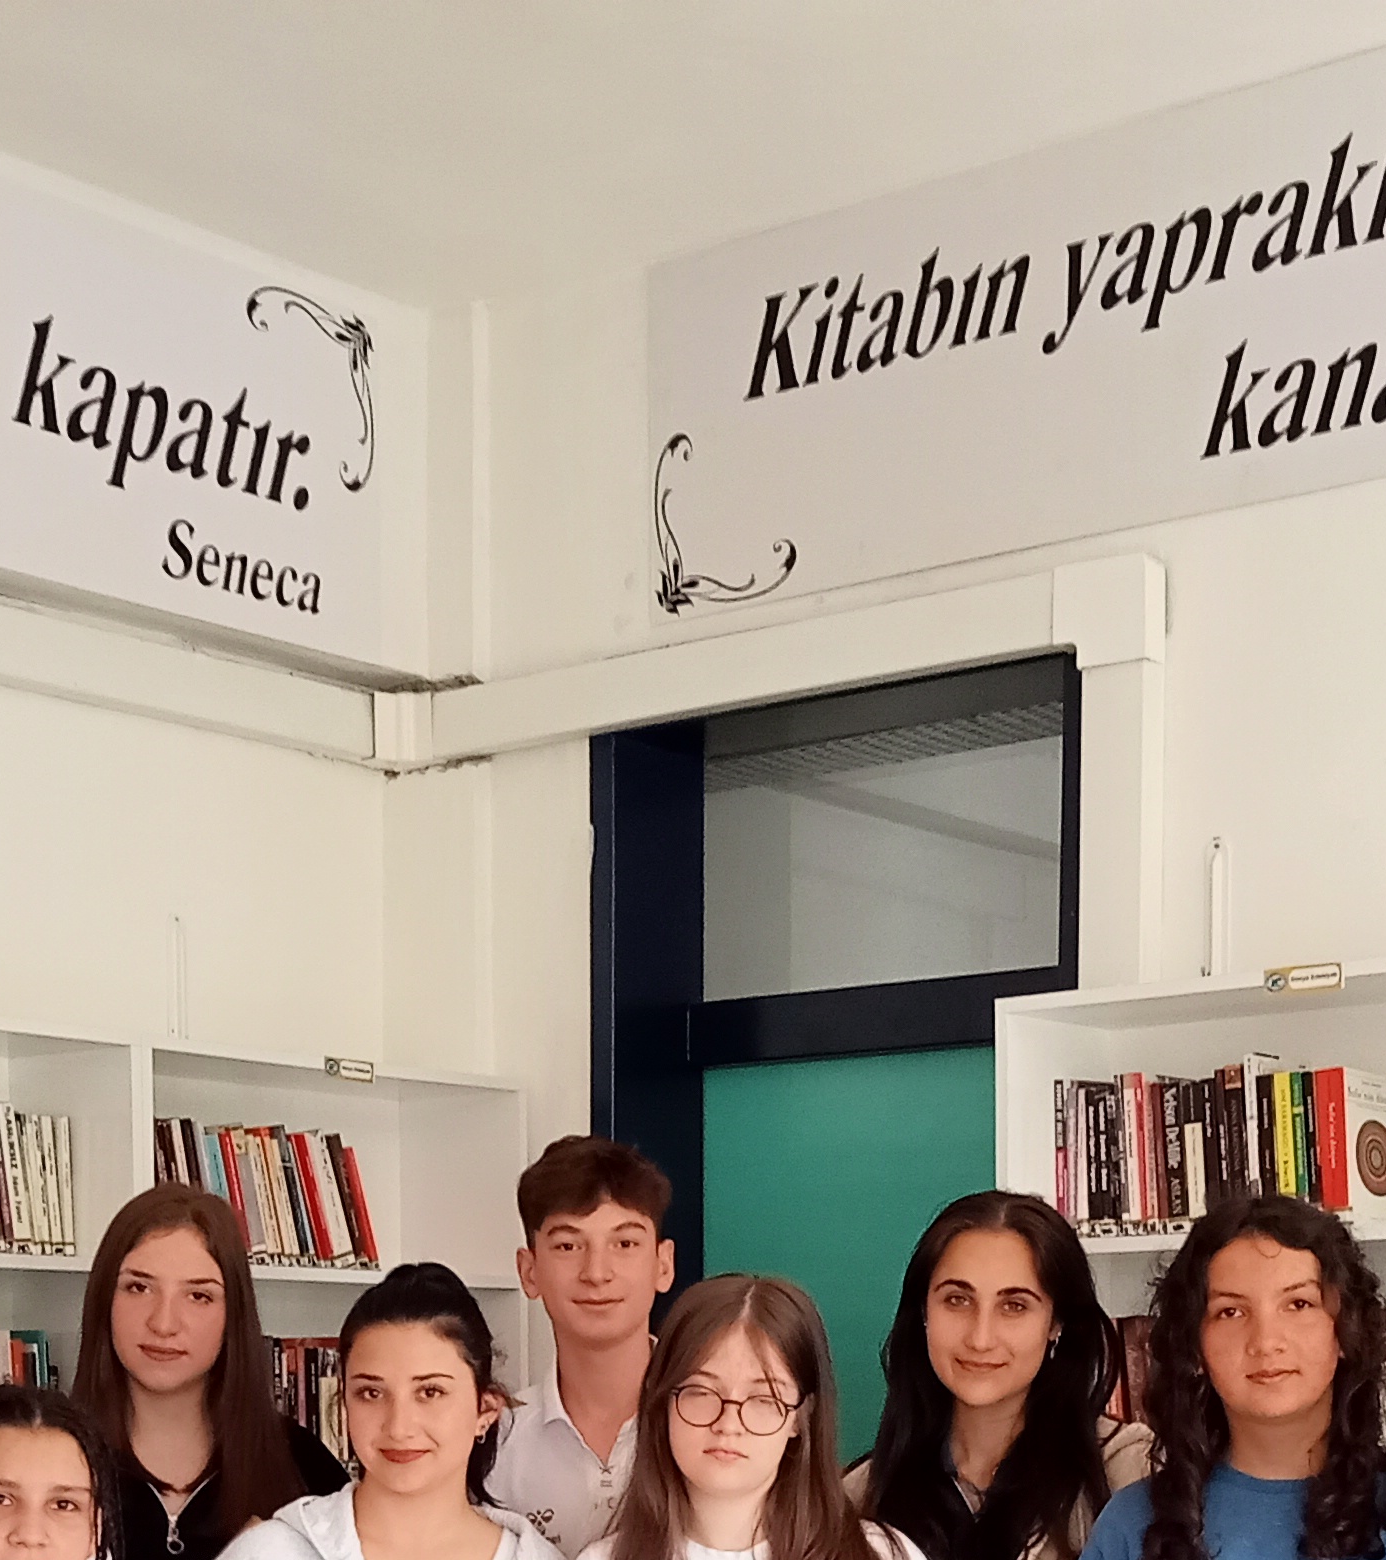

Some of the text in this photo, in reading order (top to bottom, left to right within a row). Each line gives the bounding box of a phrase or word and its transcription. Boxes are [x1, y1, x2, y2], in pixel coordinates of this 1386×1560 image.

[743, 247, 1032, 402] Kitabın
[12, 314, 311, 511] kapatır.
[161, 519, 322, 616] Seneca
[1162, 1086, 1178, 1126] Nelson
